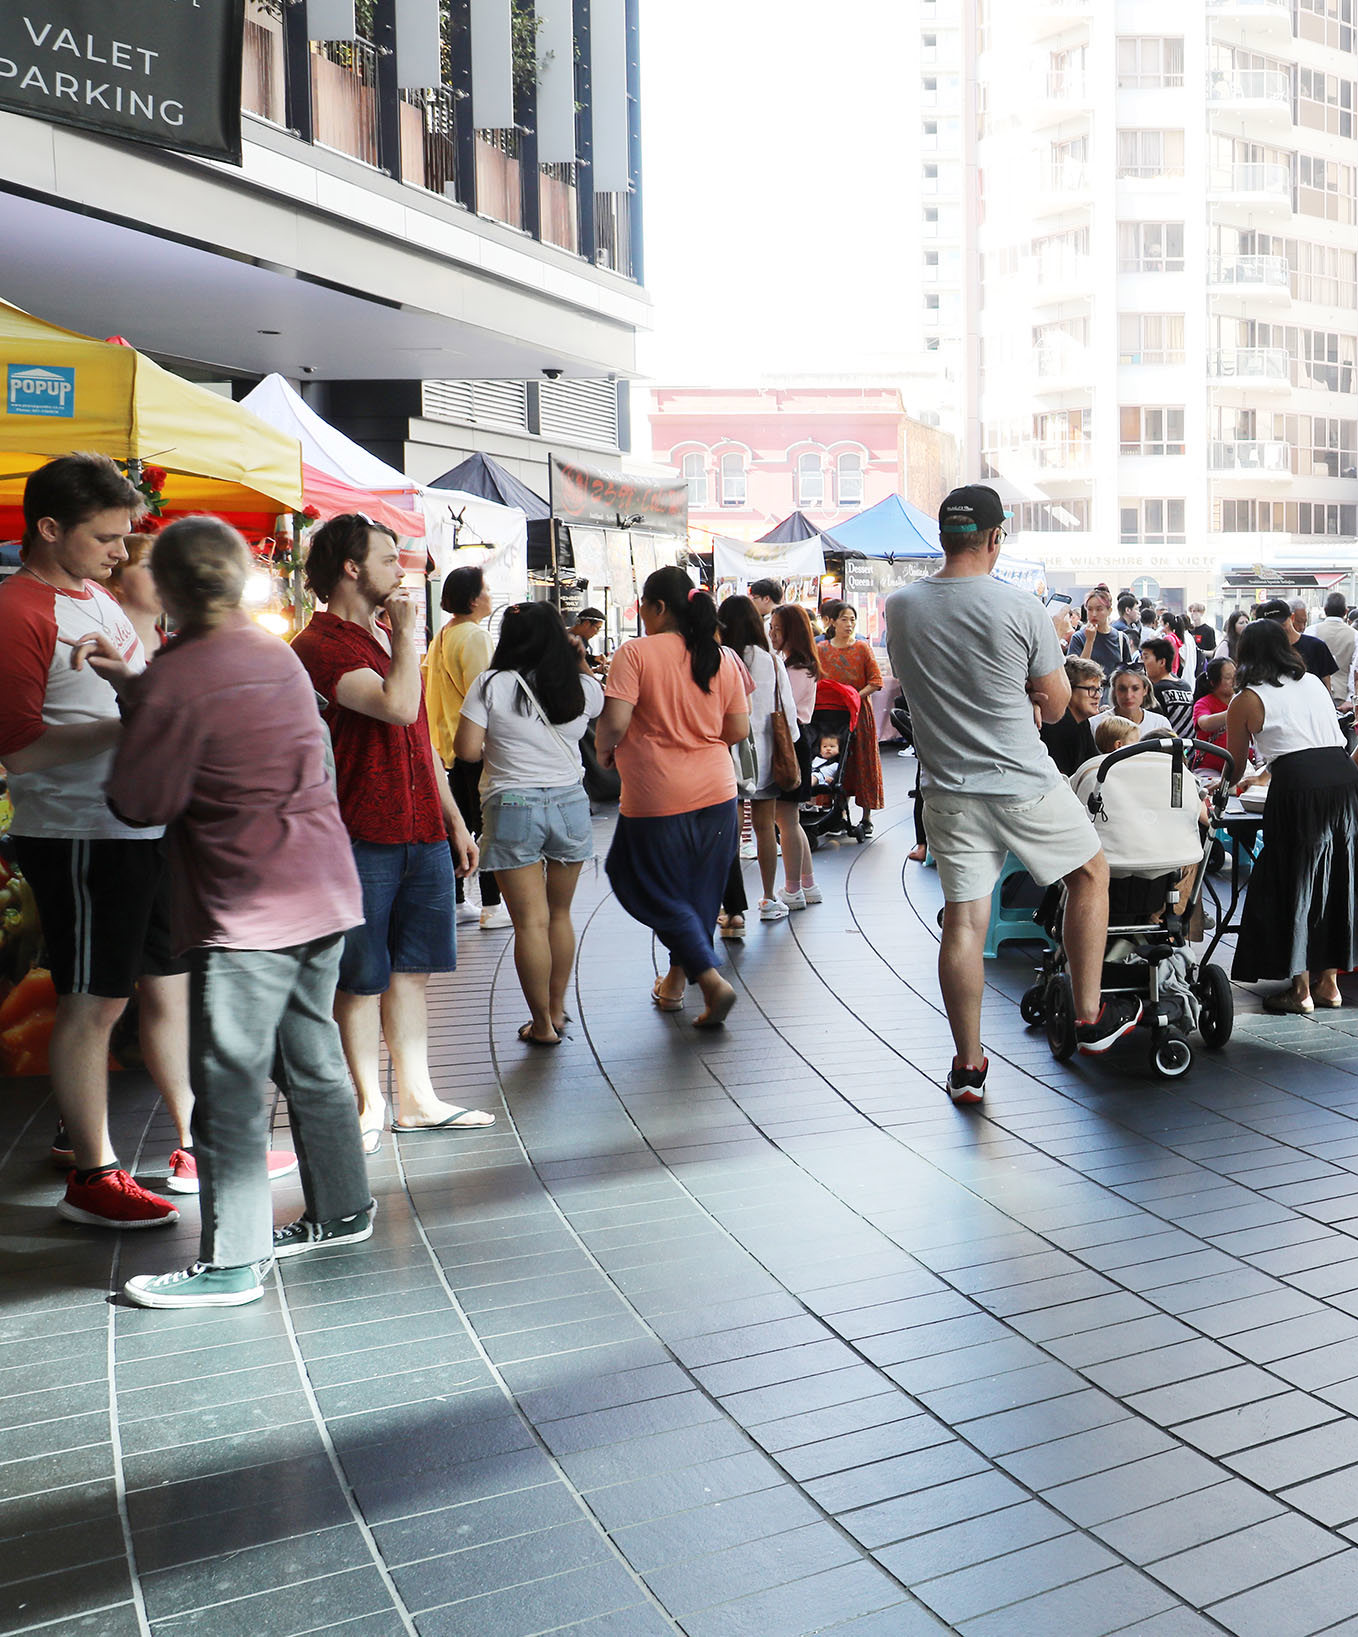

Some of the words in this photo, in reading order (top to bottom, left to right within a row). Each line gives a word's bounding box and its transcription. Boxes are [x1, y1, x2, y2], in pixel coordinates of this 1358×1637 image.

[23, 16, 159, 75] VALET
[0, 57, 184, 126] PARKING
[11, 379, 72, 406] POPUP
[848, 563, 873, 574] Dessert
[1070, 556, 1143, 565] WILTSHIRE
[1151, 556, 1168, 565] ON
